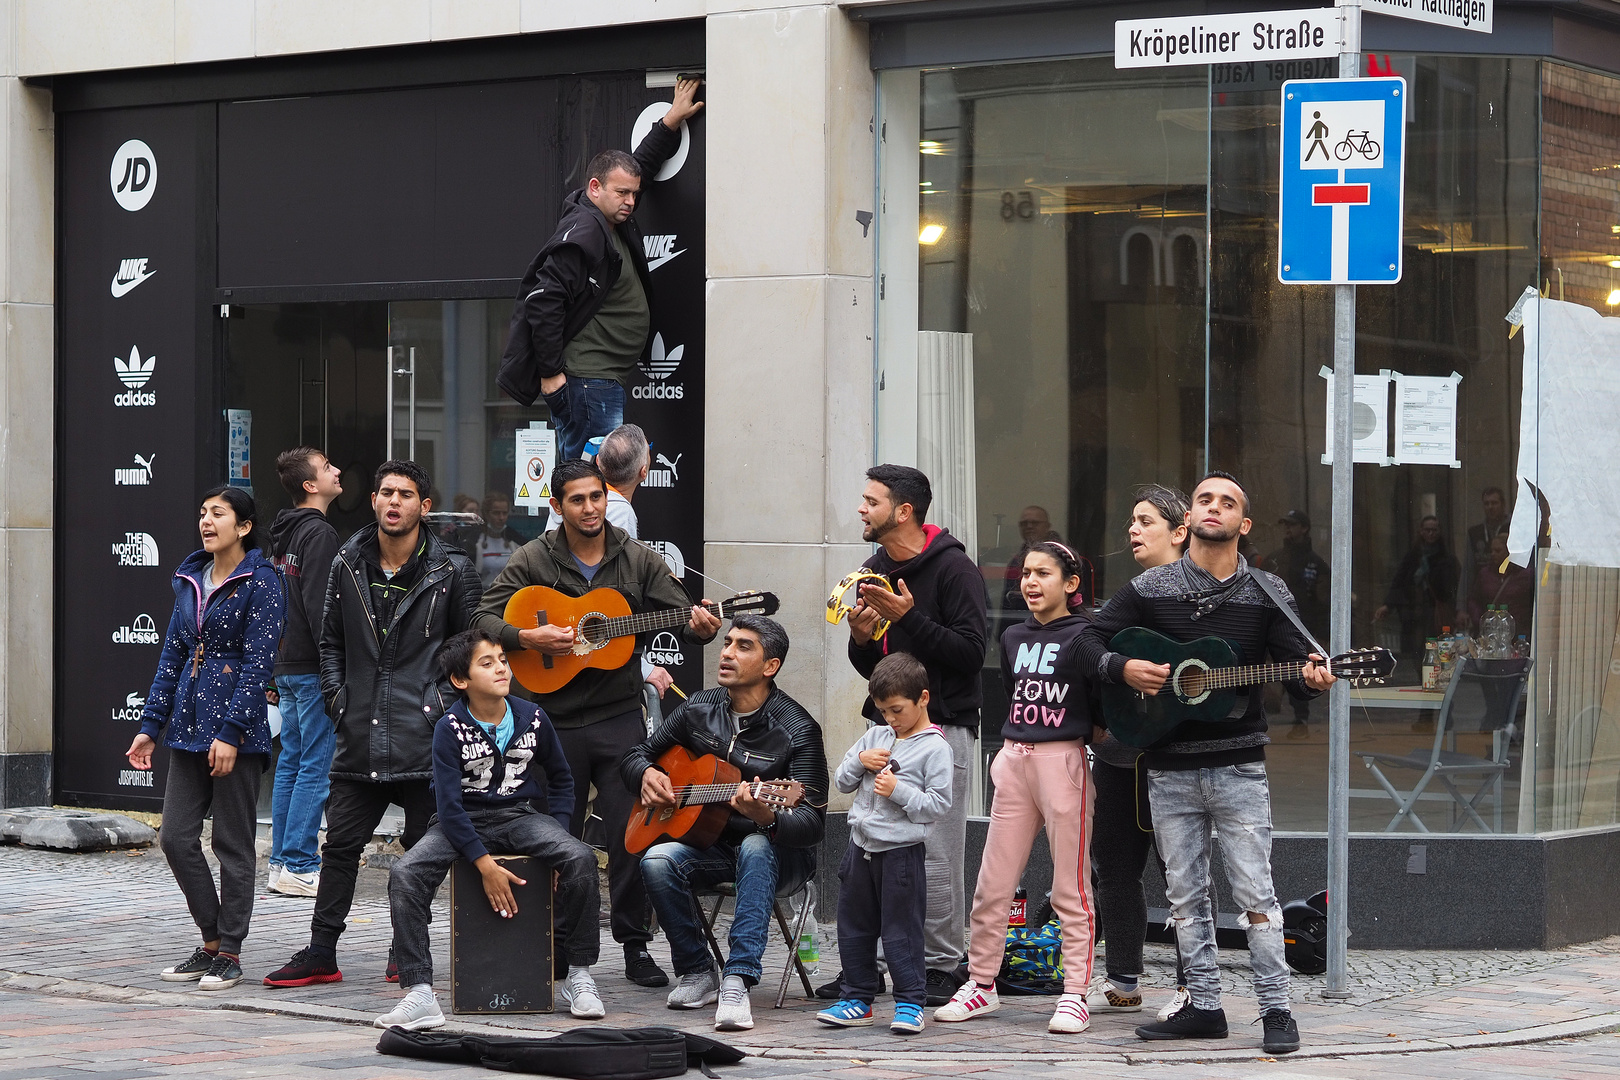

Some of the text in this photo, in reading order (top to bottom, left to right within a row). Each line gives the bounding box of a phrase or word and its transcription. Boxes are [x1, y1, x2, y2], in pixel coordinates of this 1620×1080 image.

[1130, 19, 1324, 62] Kröpeliner Straße
[117, 157, 151, 193] JD
[118, 257, 149, 280] NIKE
[114, 390, 156, 406] adidas
[632, 382, 684, 399] adidas
[115, 468, 147, 485] PUMA
[125, 532, 143, 544] THE
[112, 543, 143, 555] NORTH
[120, 554, 143, 566] FACE
[112, 626, 159, 644] ellesse
[1013, 642, 1060, 674] ME
[1012, 679, 1069, 703] EOW
[1009, 703, 1066, 728] EOW
[118, 770, 153, 787] JDSPORTS.DE
[1009, 907, 1022, 916] ola
